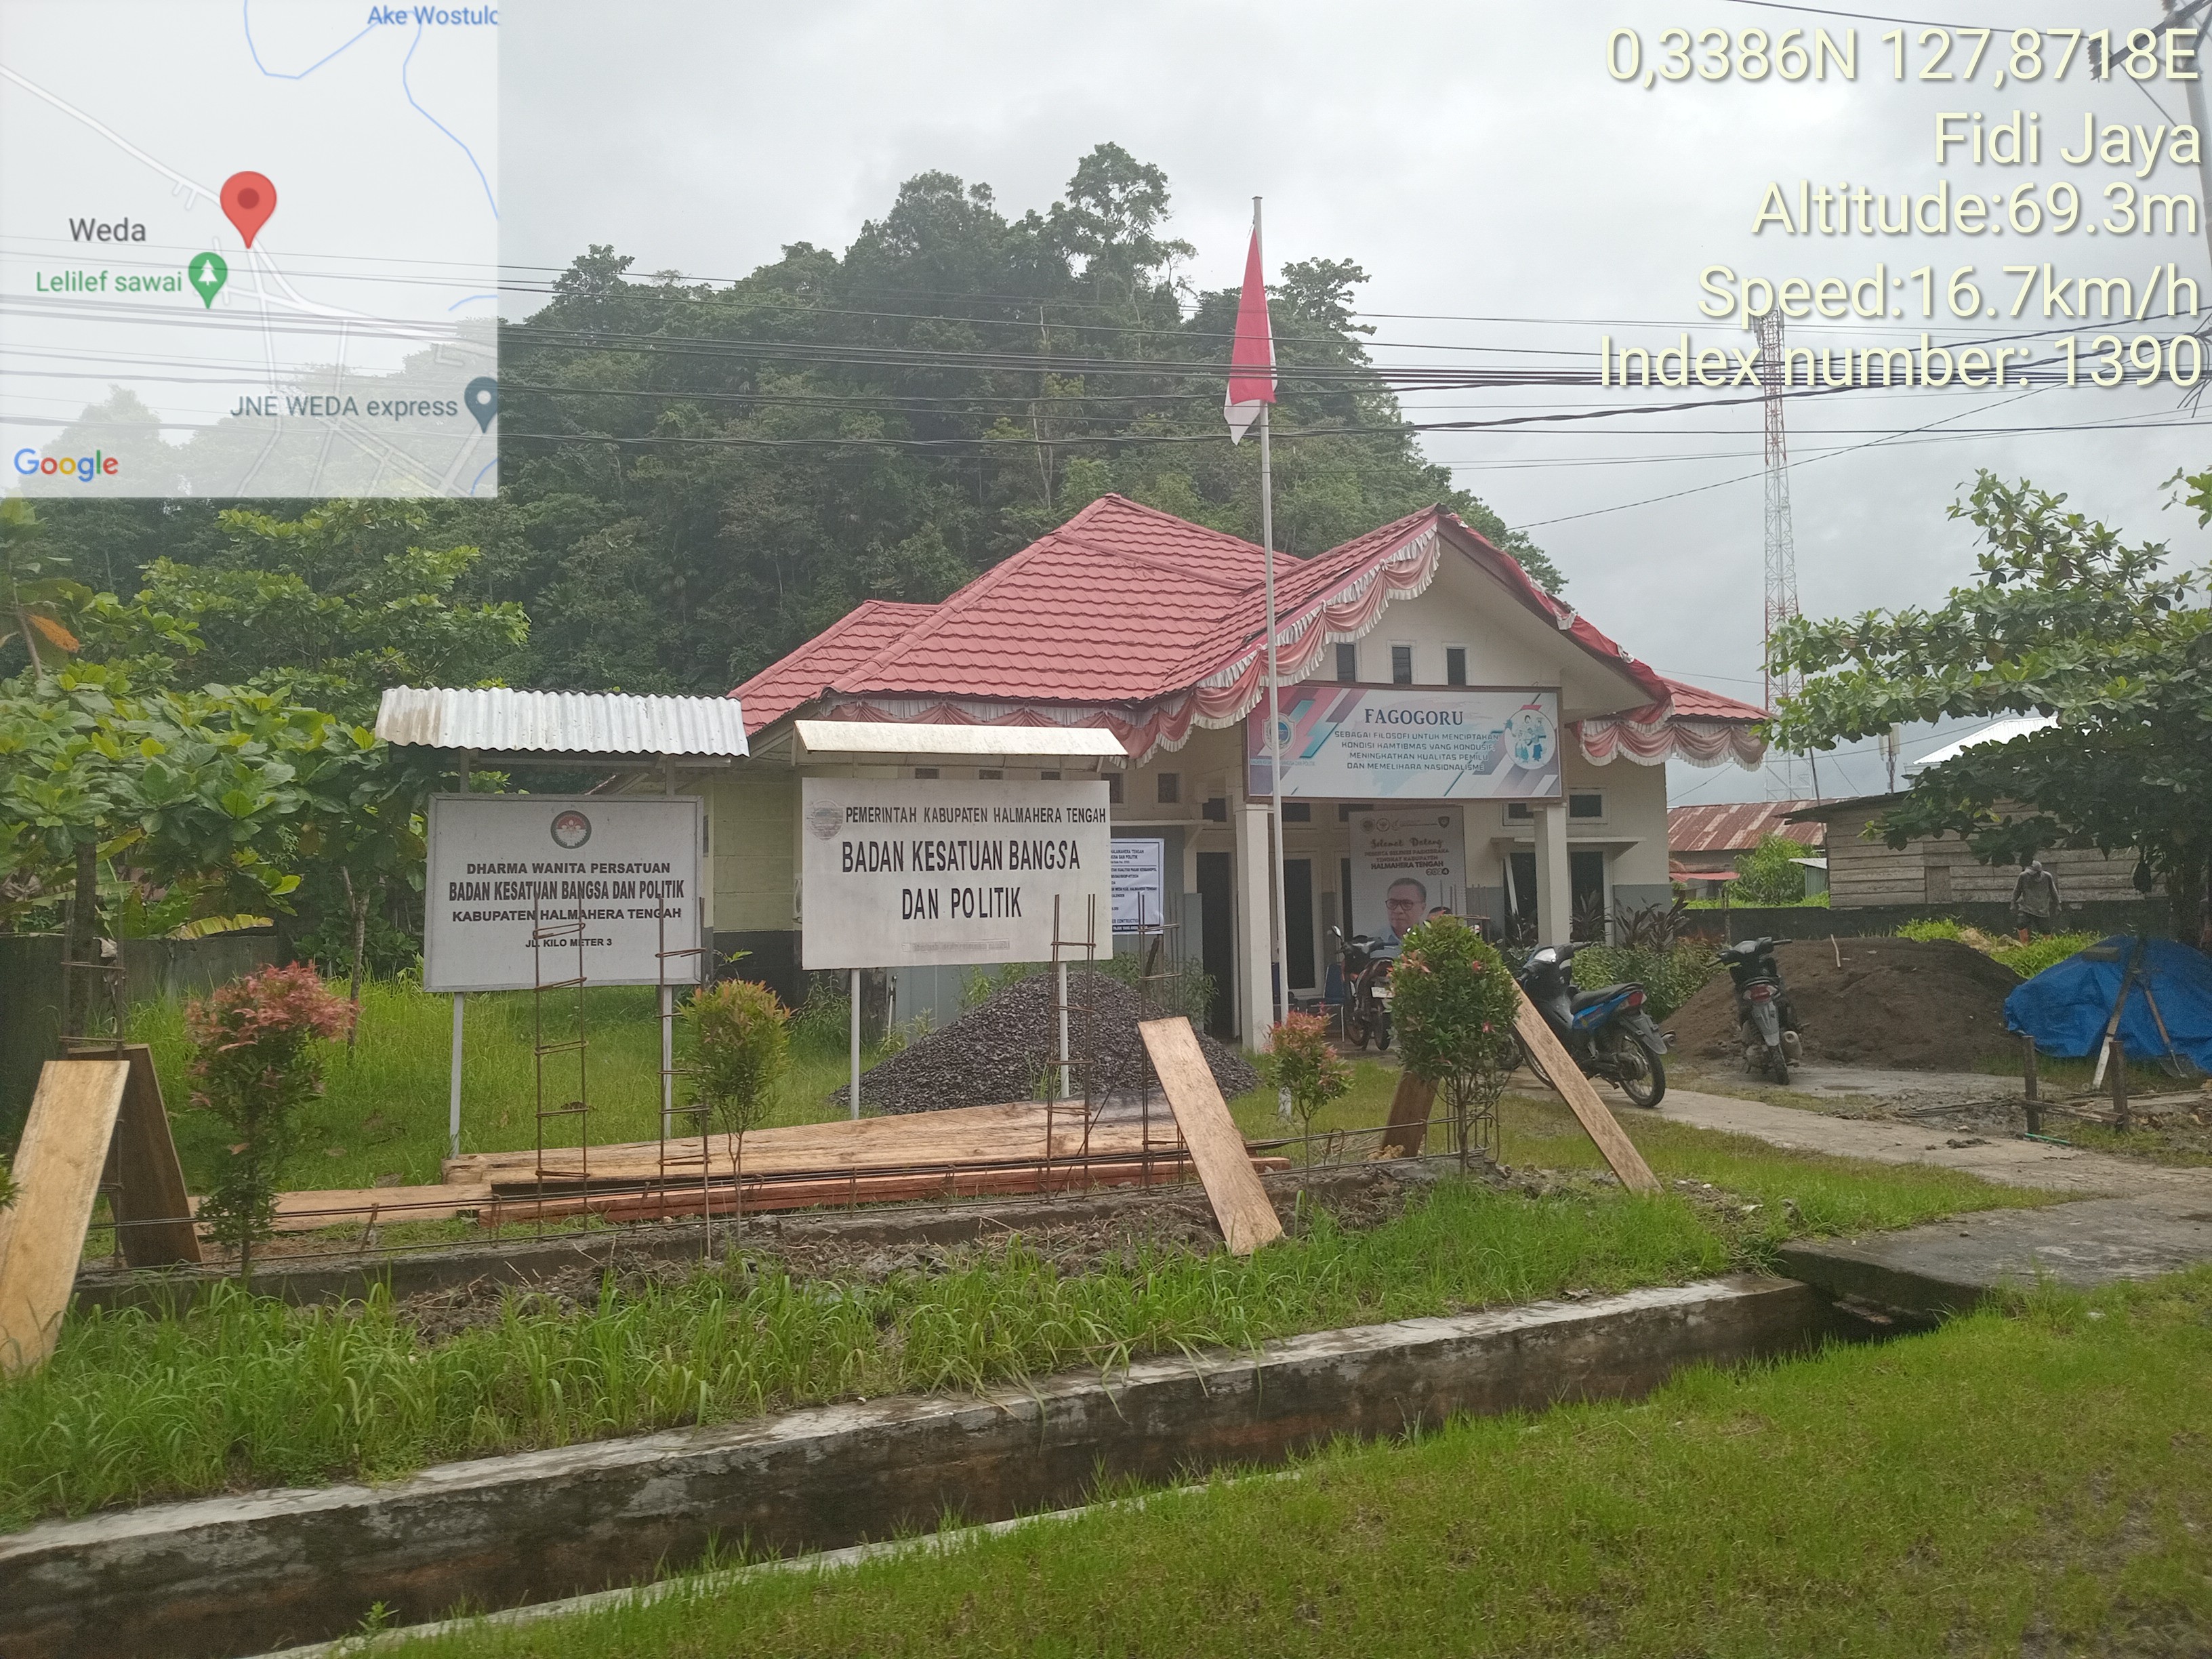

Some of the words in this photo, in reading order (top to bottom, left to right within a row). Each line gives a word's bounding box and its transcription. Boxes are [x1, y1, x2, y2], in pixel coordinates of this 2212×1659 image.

[1364, 709, 1463, 726] FAGOGORU
[846, 808, 917, 823] PEMERINTAH
[924, 808, 988, 823] KABUPATEN
[994, 808, 1062, 823] HALMAHERA
[1067, 808, 1106, 823] TENGAH
[842, 841, 904, 873] BADAN
[913, 841, 1002, 872] KESATUAN
[1009, 840, 1080, 869] BANGSA
[467, 863, 527, 874] DHARMA
[532, 863, 586, 874] WANITA
[590, 863, 670, 874] PERSATUAN
[449, 882, 490, 901] BADAN
[494, 881, 557, 900] KESATUAN
[562, 880, 609, 900] BANGSA
[613, 880, 635, 899] DAN
[640, 880, 684, 899] POLITIK
[902, 888, 939, 920] DAN
[951, 887, 1022, 919] POLITIK
[453, 910, 535, 922] KABUPATEN
[540, 909, 624, 920] HALMAHERA
[628, 908, 681, 919] TENGAH
[544, 939, 567, 947] KILO
[570, 939, 604, 947] METER
[607, 938, 612, 946] 3
